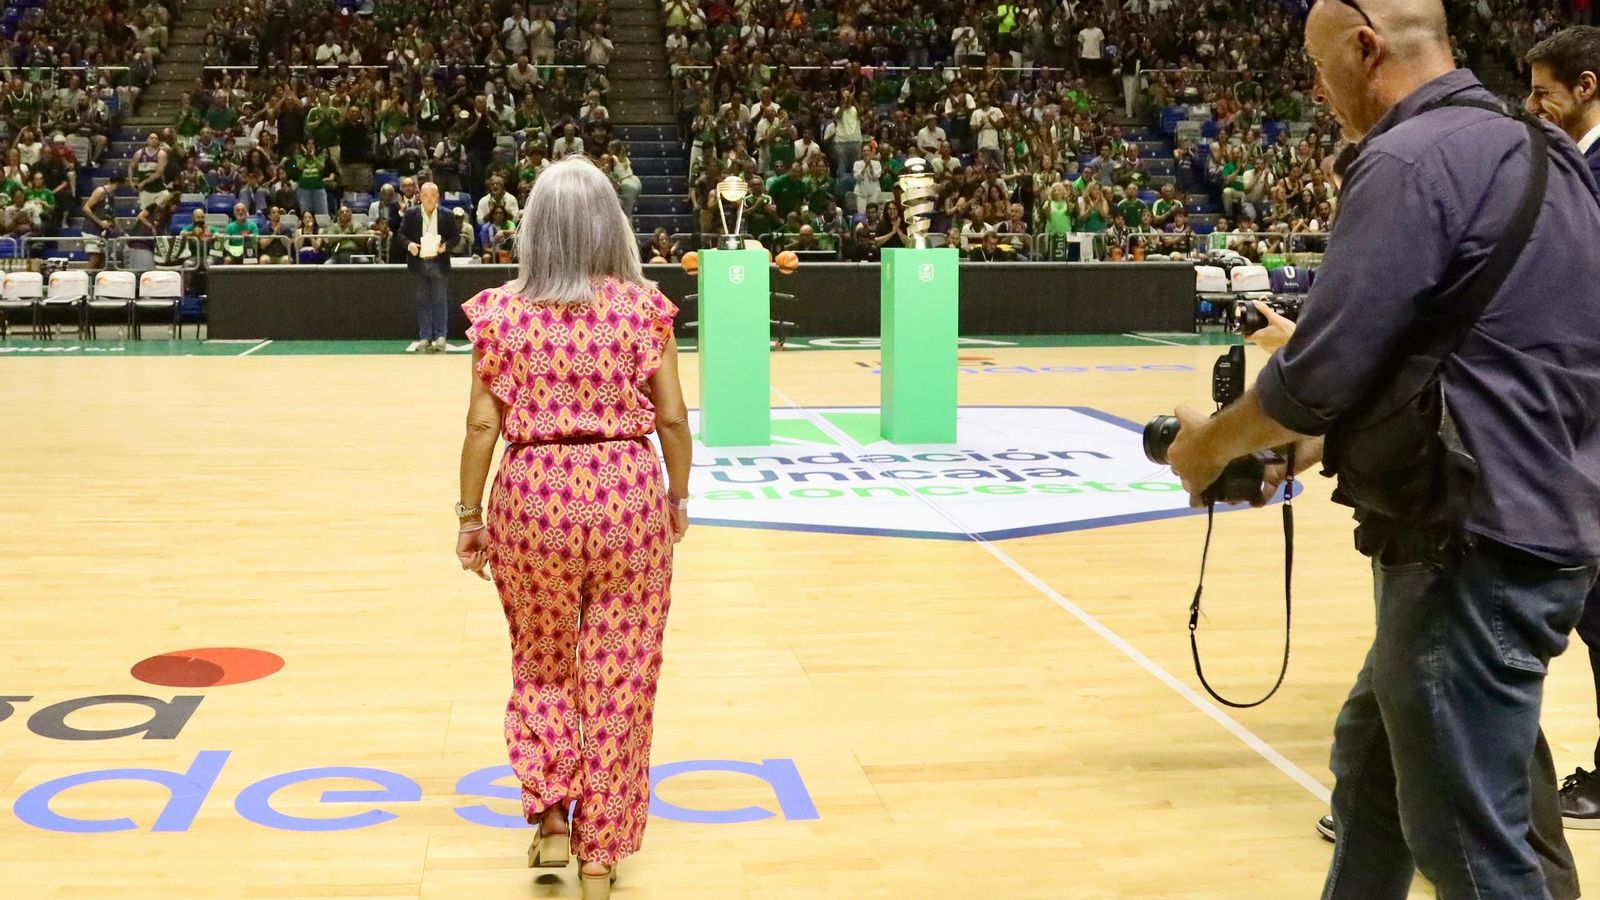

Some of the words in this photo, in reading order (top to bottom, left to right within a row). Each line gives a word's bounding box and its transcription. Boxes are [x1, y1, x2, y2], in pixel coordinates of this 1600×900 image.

[691, 448, 1113, 467] undación
[711, 464, 1080, 483] Unicaja
[688, 481, 1185, 500] aloncesto
